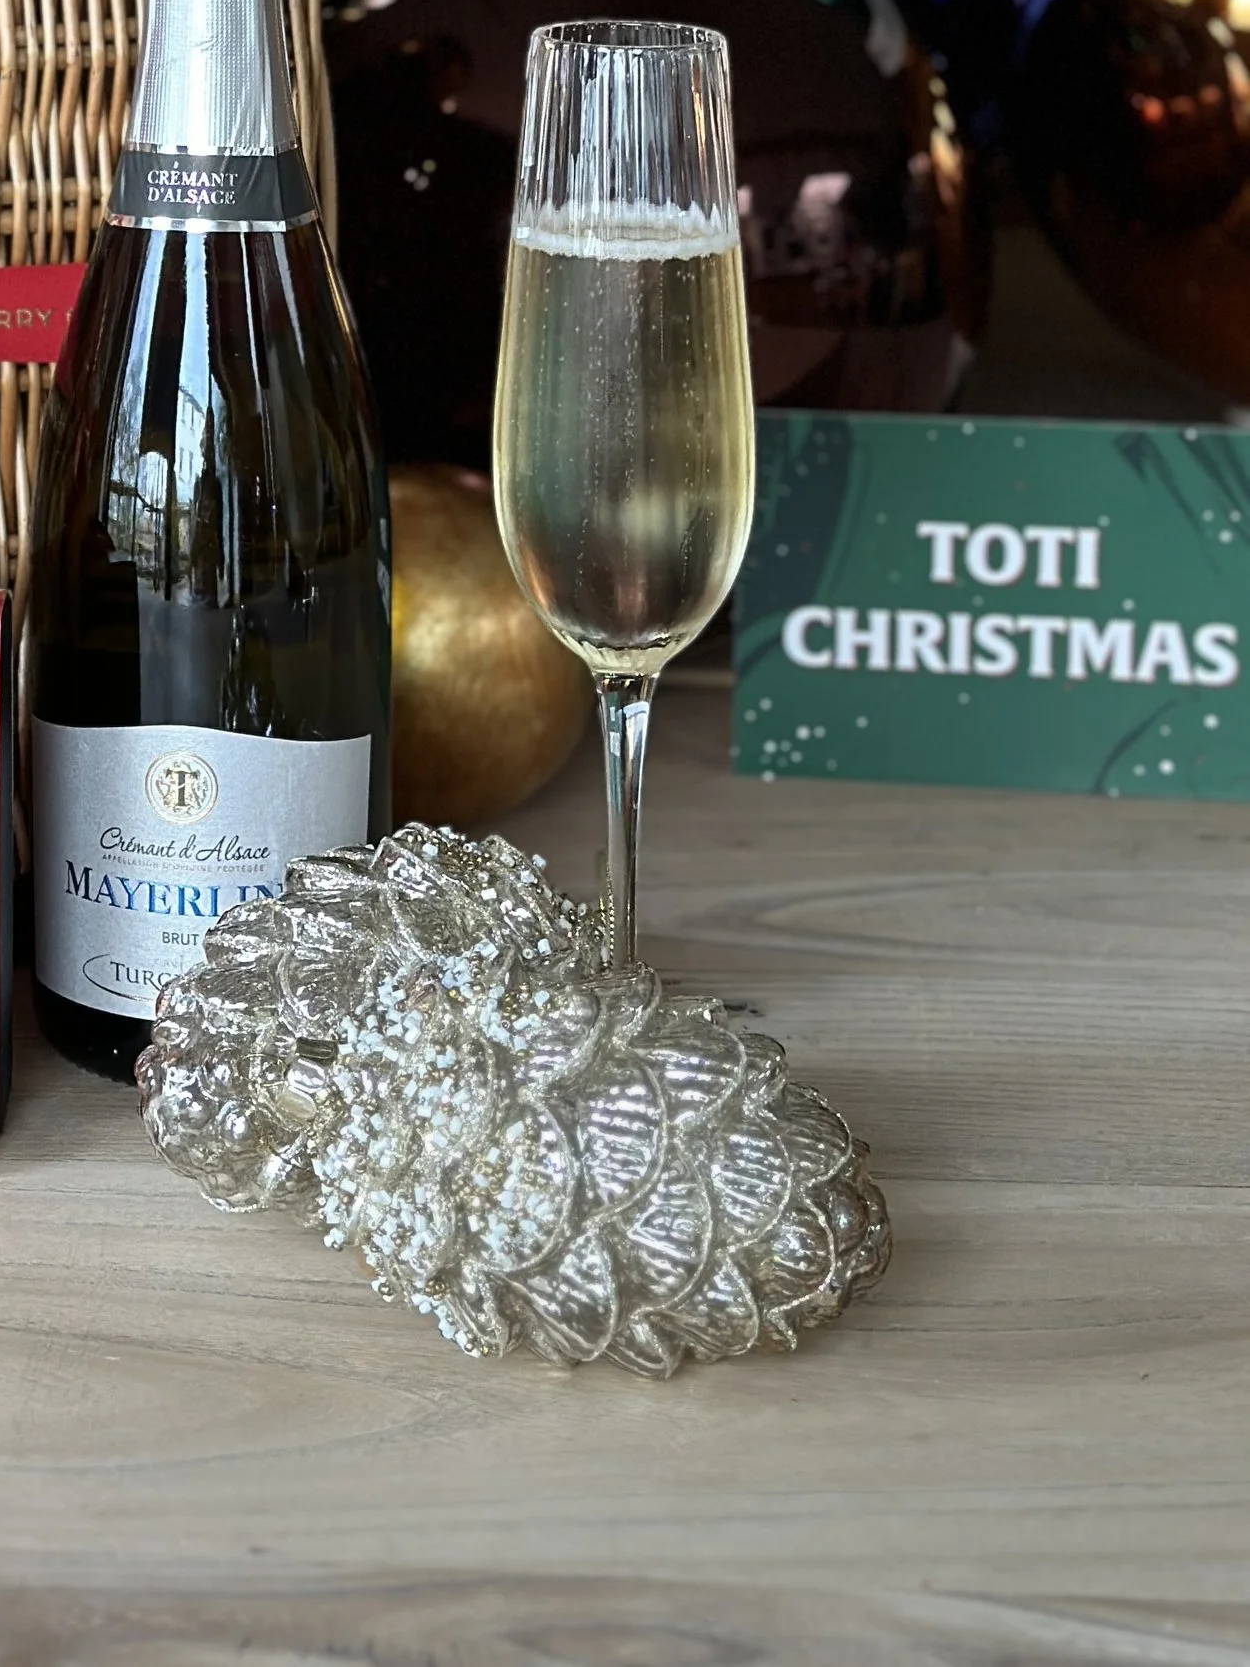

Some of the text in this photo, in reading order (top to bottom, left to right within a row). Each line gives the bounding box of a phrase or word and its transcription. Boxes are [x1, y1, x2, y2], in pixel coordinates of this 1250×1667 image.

[916, 521, 1102, 589] TOTI
[780, 604, 1240, 688] CHRISTMAS
[100, 826, 176, 859] Crémant
[162, 931, 200, 947] BRUT
[110, 960, 182, 992] TURC
